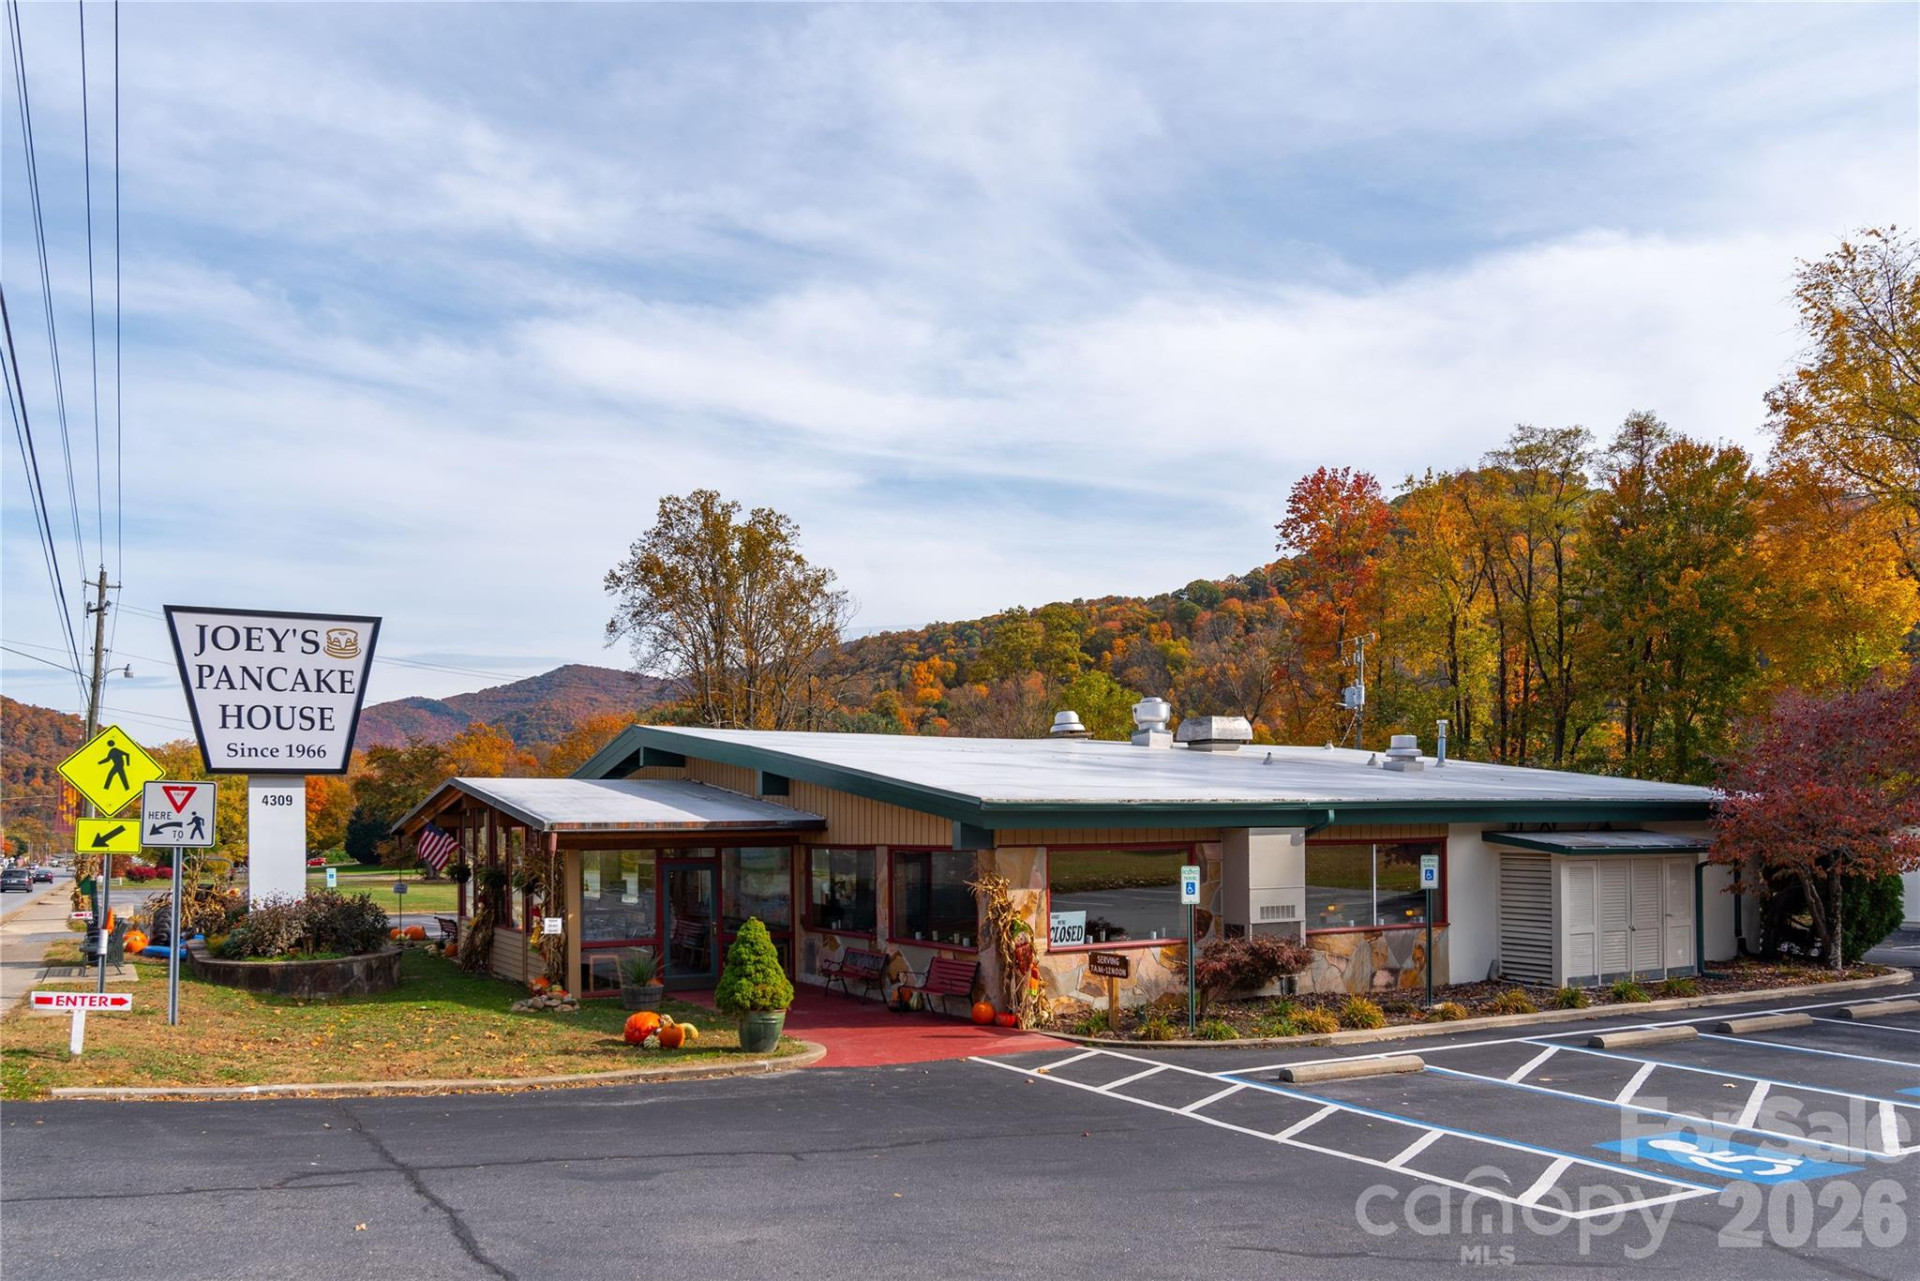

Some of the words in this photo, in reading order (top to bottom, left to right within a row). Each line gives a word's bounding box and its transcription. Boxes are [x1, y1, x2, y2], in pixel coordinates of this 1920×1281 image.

[194, 624, 320, 657] JOEY'S
[195, 664, 355, 694] PANCAKE
[218, 704, 335, 732] HOUSE
[226, 743, 280, 758] Since
[285, 744, 327, 759] 1966
[261, 795, 293, 806] 4309
[148, 811, 172, 820] HERE
[173, 830, 184, 838] TO
[1050, 925, 1083, 943] CLOSED
[1097, 955, 1120, 966] SERVING
[55, 995, 109, 1007] ENTER
